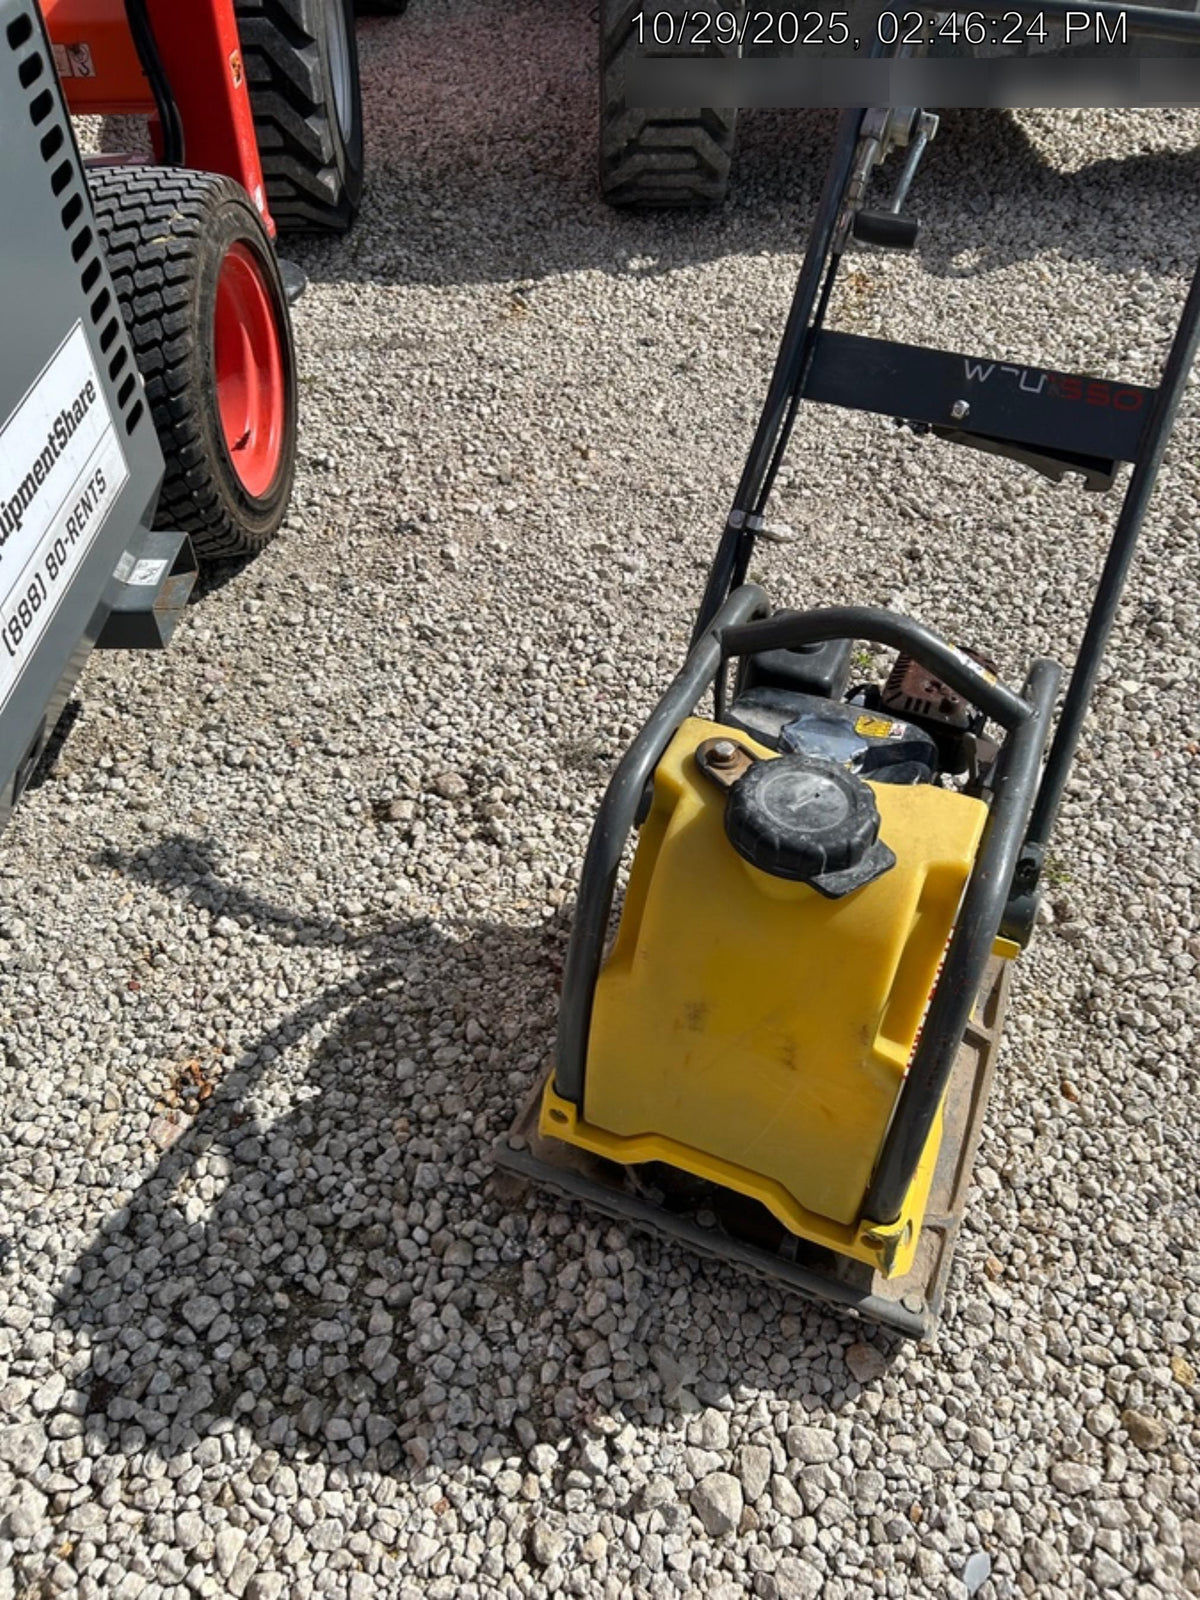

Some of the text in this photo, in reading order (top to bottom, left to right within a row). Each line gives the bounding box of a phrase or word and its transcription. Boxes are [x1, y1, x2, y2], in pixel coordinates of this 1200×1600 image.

[0, 380, 96, 552] uipmentShare
[2, 468, 107, 656] (888) 80-RENTS
